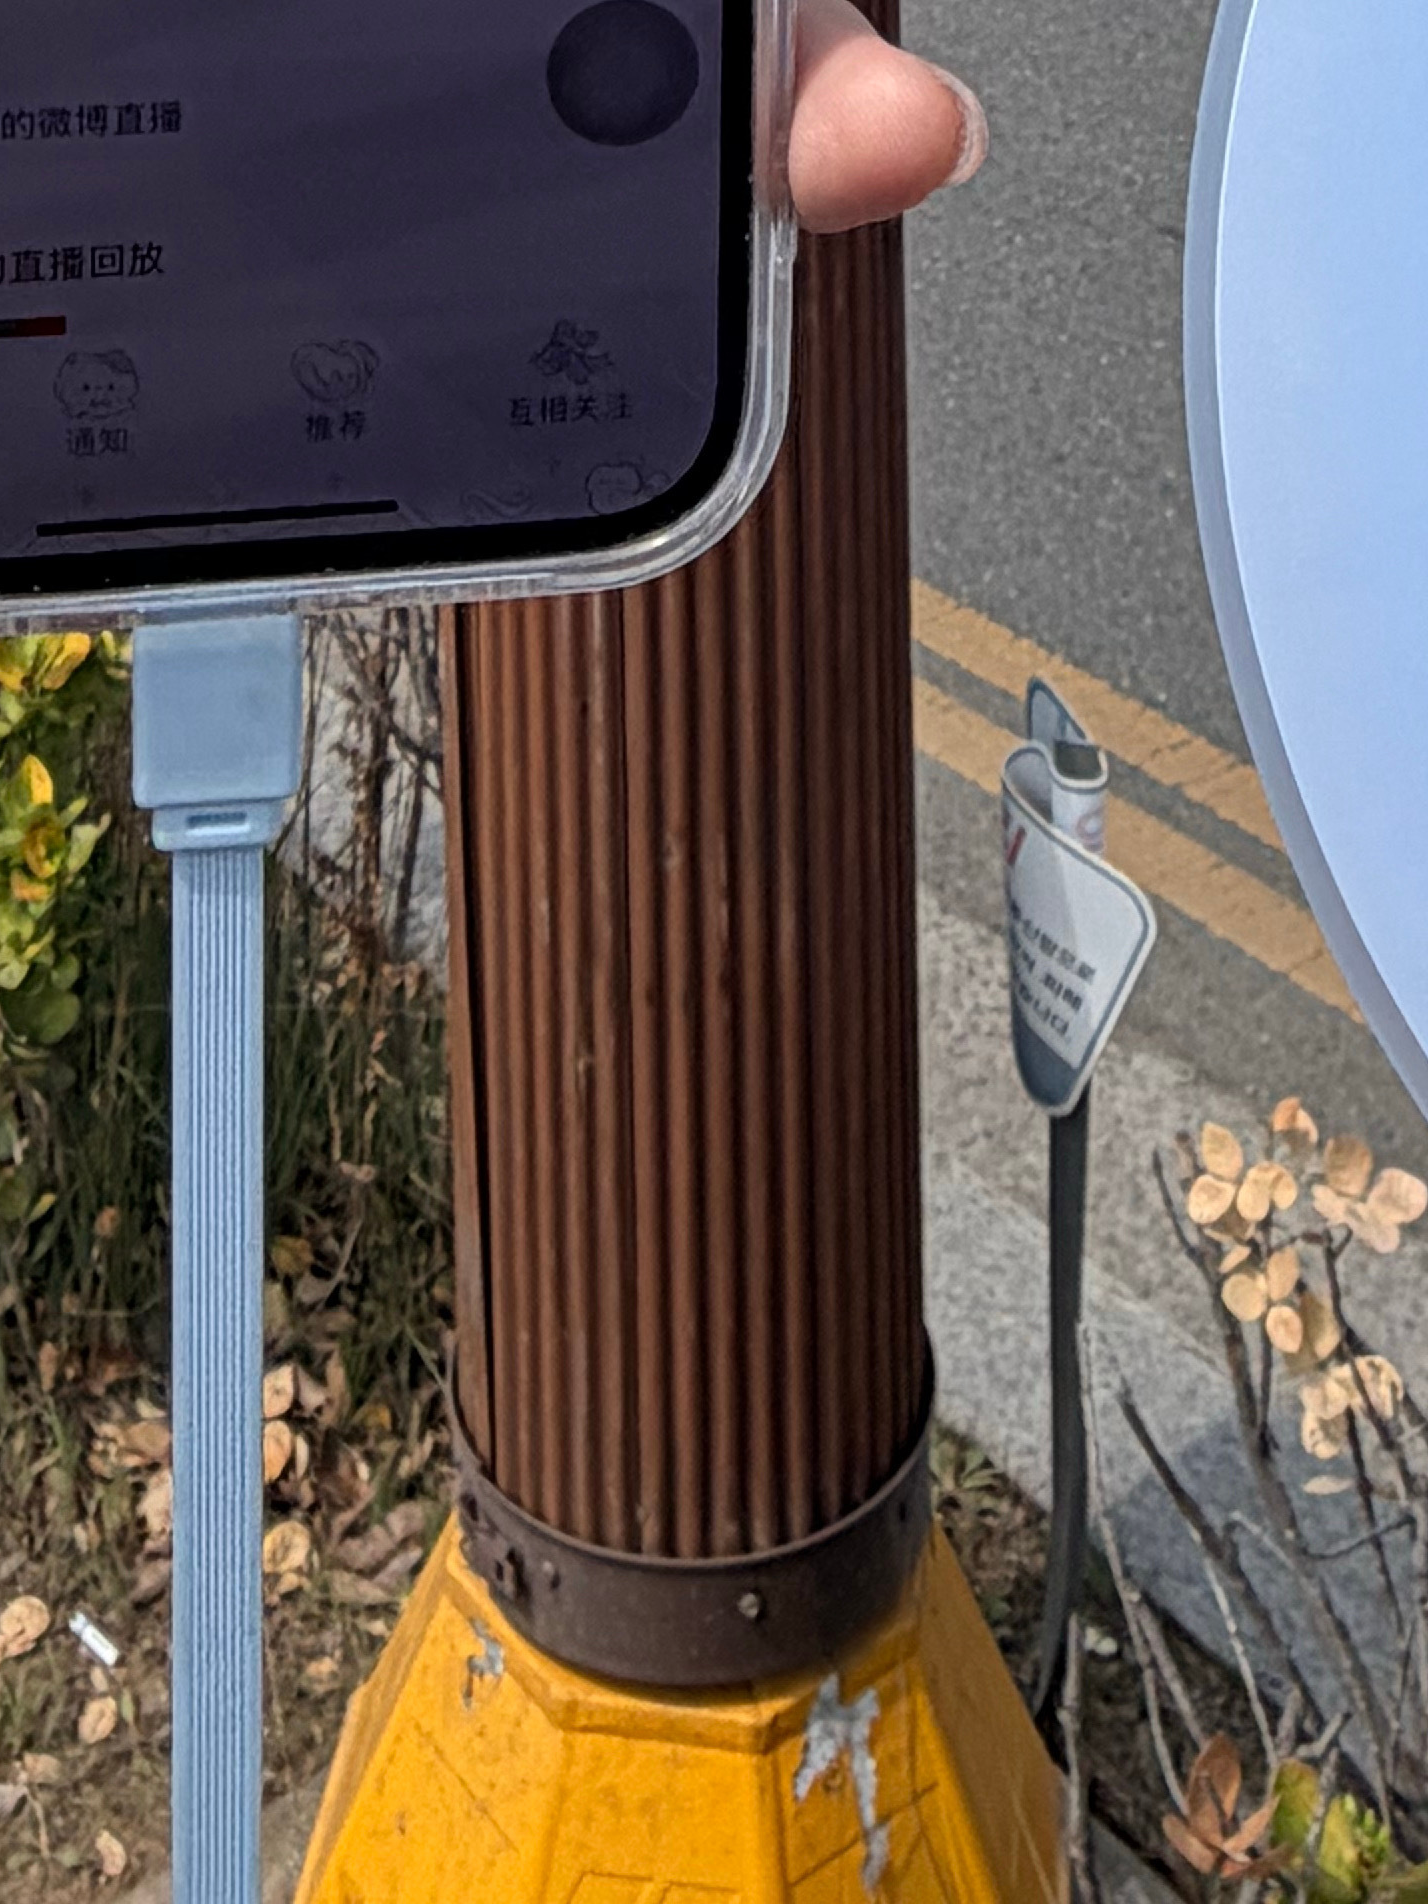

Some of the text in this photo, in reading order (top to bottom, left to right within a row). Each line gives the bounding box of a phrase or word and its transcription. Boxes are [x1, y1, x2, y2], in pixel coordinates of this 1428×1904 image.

[64, 425, 130, 458] 通知
[304, 410, 368, 445] 推荐
[507, 392, 634, 428] 互相关注
